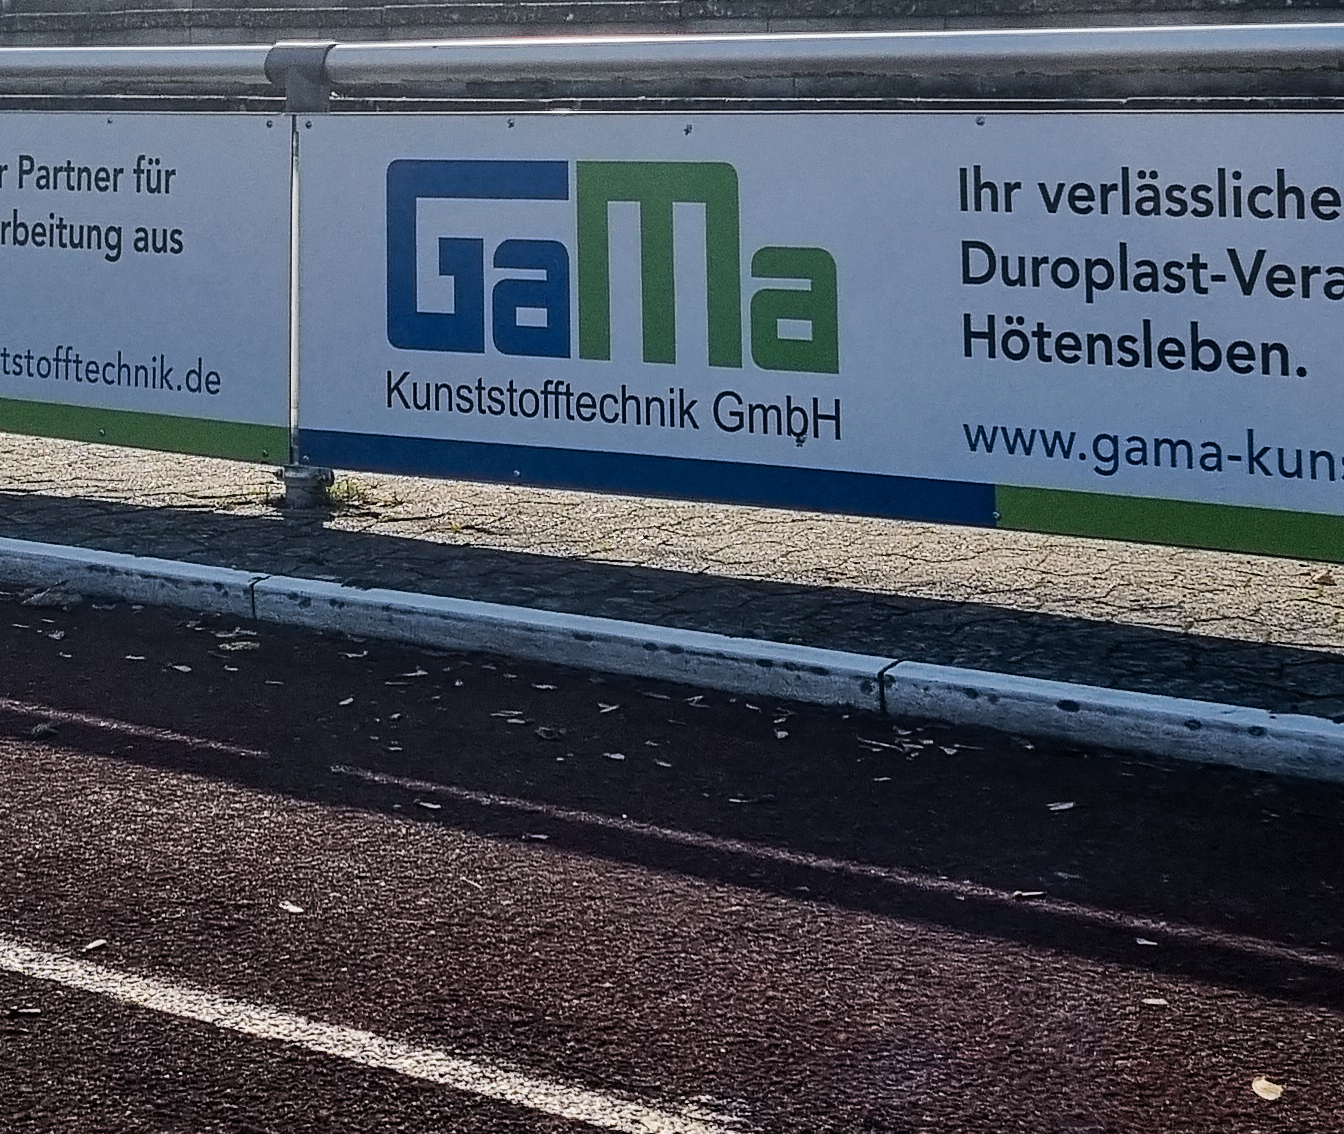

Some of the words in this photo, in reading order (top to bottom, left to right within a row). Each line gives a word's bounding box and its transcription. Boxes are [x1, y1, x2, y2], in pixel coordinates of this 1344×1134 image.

[18, 154, 125, 193] Partner
[132, 154, 177, 195] für
[959, 164, 1022, 213] Ihr
[133, 226, 184, 255] aus
[963, 312, 1308, 378] Hötensleben.
[386, 369, 700, 430] Kunststofftechnik
[712, 390, 842, 441] GmbH
